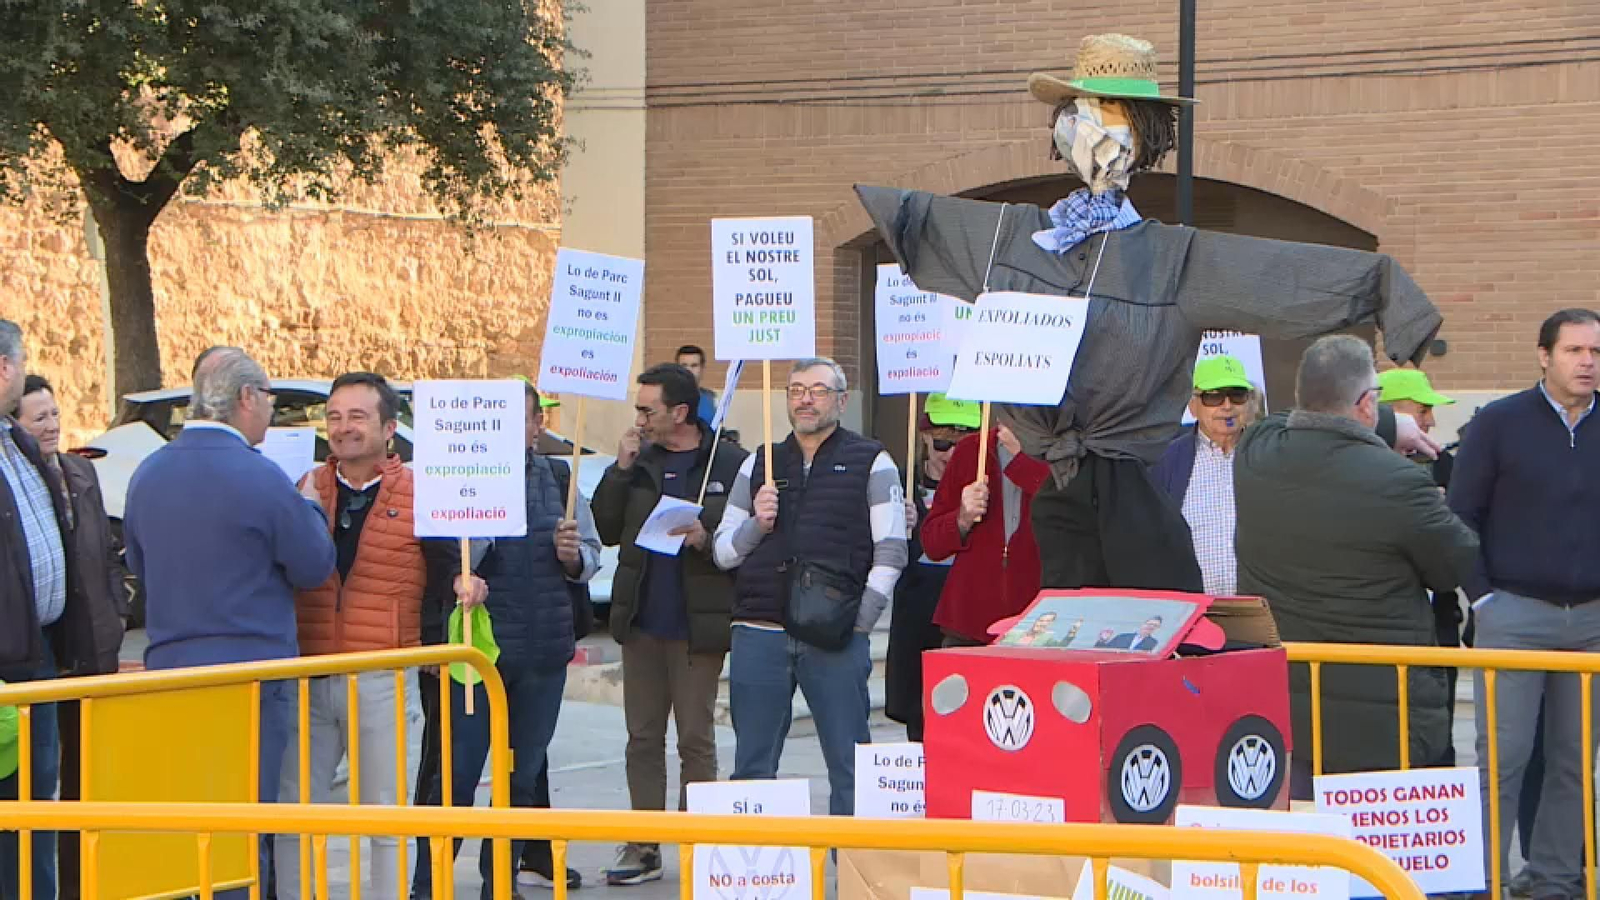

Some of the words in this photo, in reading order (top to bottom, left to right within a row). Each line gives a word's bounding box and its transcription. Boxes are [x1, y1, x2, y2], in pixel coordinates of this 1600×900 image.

[731, 232, 744, 246] SI
[750, 231, 795, 245] VOLEU
[726, 250, 741, 264] EL
[746, 249, 800, 264] NOSTRE
[567, 263, 581, 276] Lo
[584, 266, 599, 279] de
[601, 268, 628, 284] Parc
[748, 267, 779, 284] SOL,
[887, 277, 899, 288] Lo
[569, 284, 611, 301] Sagunt
[613, 290, 621, 303] II
[735, 292, 793, 306] PAGUEU
[889, 294, 928, 307] Sagunt
[577, 308, 592, 319] no
[732, 311, 754, 325] UN
[759, 309, 796, 324] PREU
[899, 314, 911, 323] no
[978, 309, 1074, 328] EXPOLIADOS
[748, 328, 781, 343] JUST
[906, 349, 918, 359] és
[975, 351, 1052, 369] ESPOLIATS
[550, 365, 618, 383] expoliación
[888, 366, 940, 380] expoliació
[429, 396, 446, 409] Lo
[451, 396, 469, 409] de
[473, 396, 507, 409] Parc
[434, 419, 488, 434] Sagunt
[492, 419, 502, 431] II
[448, 442, 466, 453] no
[471, 440, 488, 453] és
[425, 462, 512, 478] expropiació
[459, 484, 477, 498] és
[431, 506, 507, 522] expoliació
[874, 752, 891, 767] Lo
[894, 754, 912, 768] de
[878, 776, 924, 793] Sagun
[1323, 788, 1388, 807] TODOS
[1393, 783, 1465, 802] GANAN
[753, 802, 763, 814] a
[891, 801, 909, 812] no
[1415, 807, 1449, 824] LOS
[1392, 854, 1449, 872] UELO
[709, 874, 733, 888] NO
[738, 876, 746, 887] a
[751, 872, 796, 886] costa
[1262, 877, 1286, 892] de
[1290, 879, 1318, 894] los
